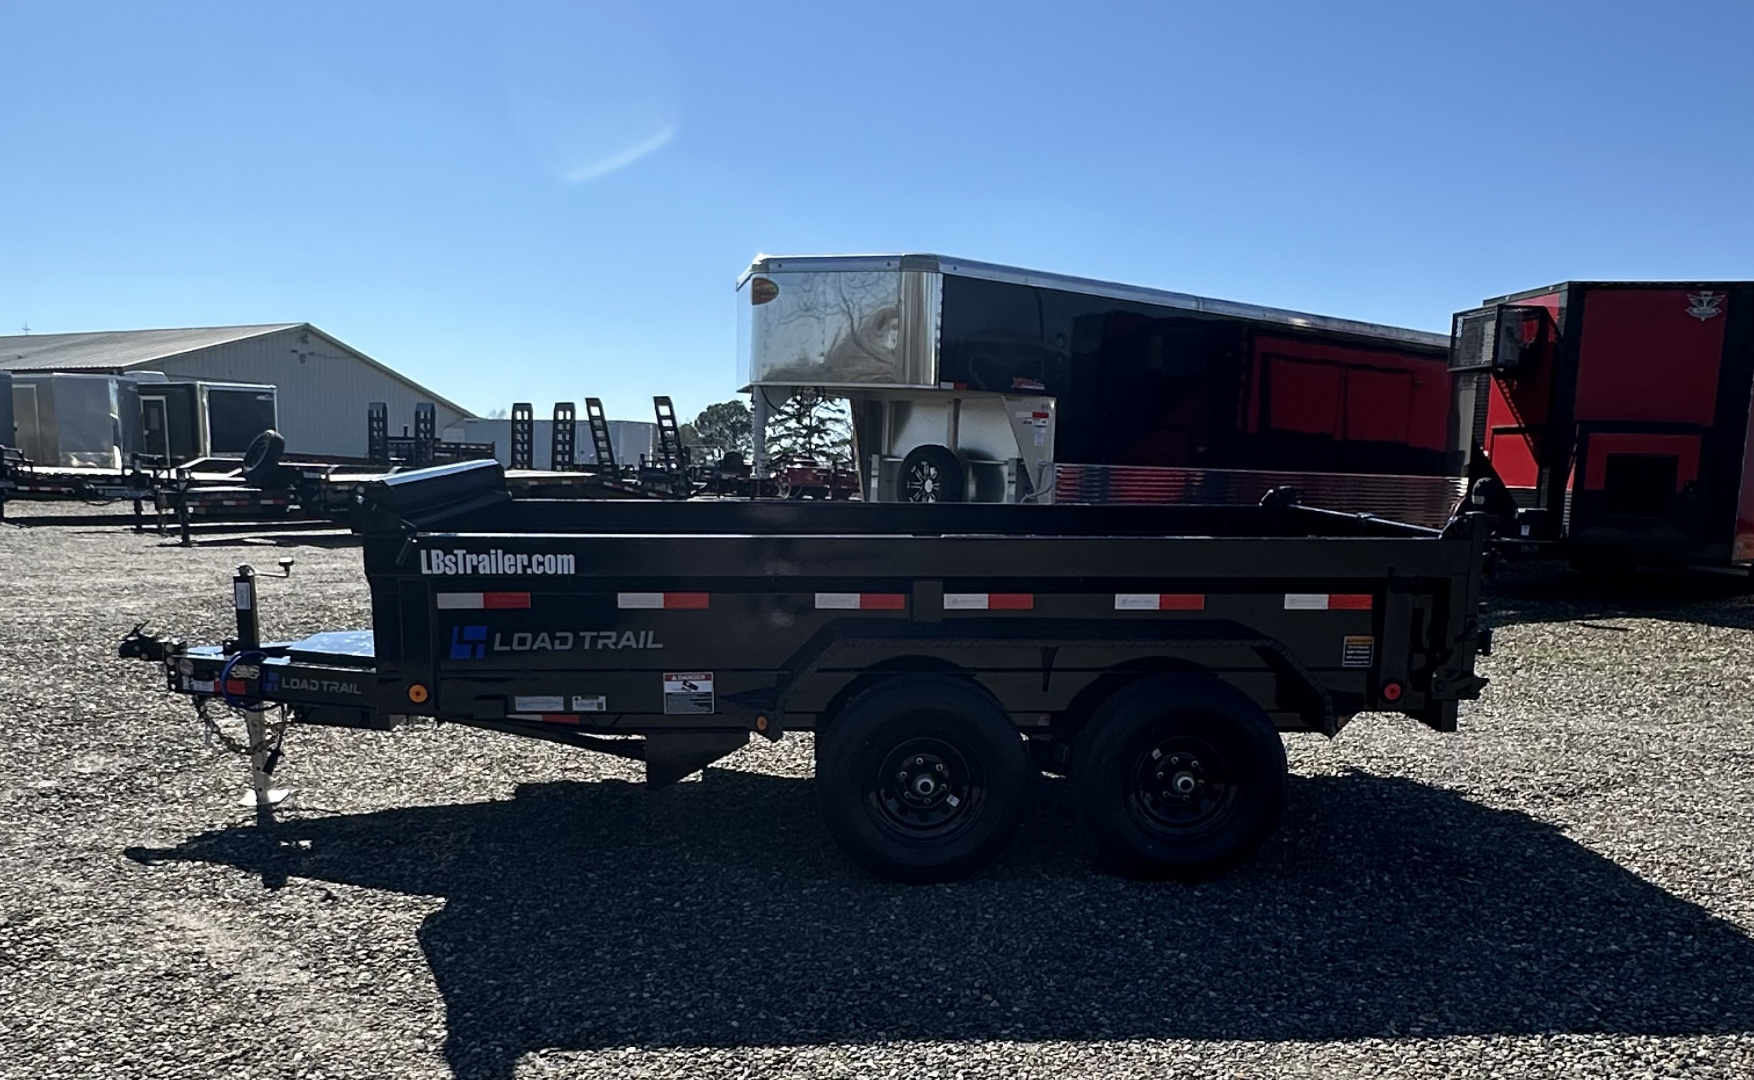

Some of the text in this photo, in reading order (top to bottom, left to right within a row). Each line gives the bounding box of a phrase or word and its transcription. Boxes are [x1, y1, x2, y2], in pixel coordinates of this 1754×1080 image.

[420, 549, 575, 575] LBsTrailer.com
[494, 631, 664, 651] LOAD TRAIL
[281, 677, 362, 694] LOAD TRAIL
